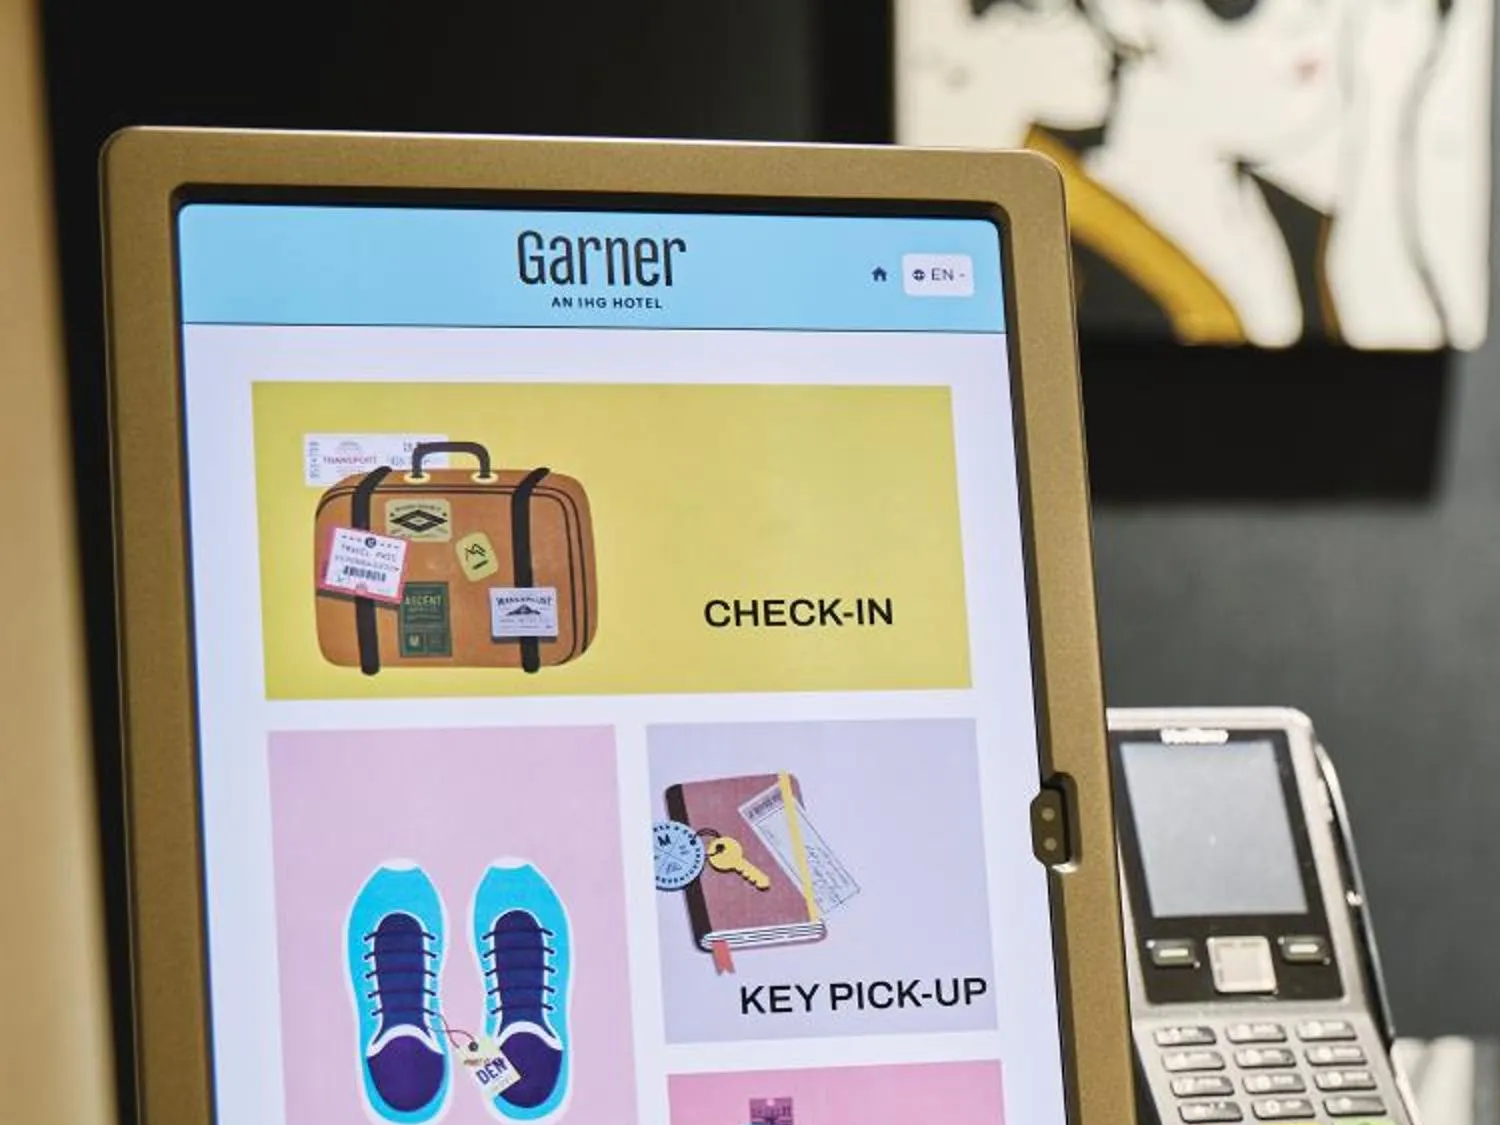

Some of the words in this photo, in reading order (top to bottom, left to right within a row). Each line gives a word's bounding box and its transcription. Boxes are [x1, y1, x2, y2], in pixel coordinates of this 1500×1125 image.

[517, 230, 687, 287] Garner
[931, 267, 954, 281] EN
[551, 297, 573, 308] AN
[578, 297, 607, 309] IHG
[613, 297, 663, 309] HOTEL
[704, 597, 893, 628] CHECK-IN
[740, 983, 820, 1015] KEY
[830, 977, 987, 1011] PICK-UP
